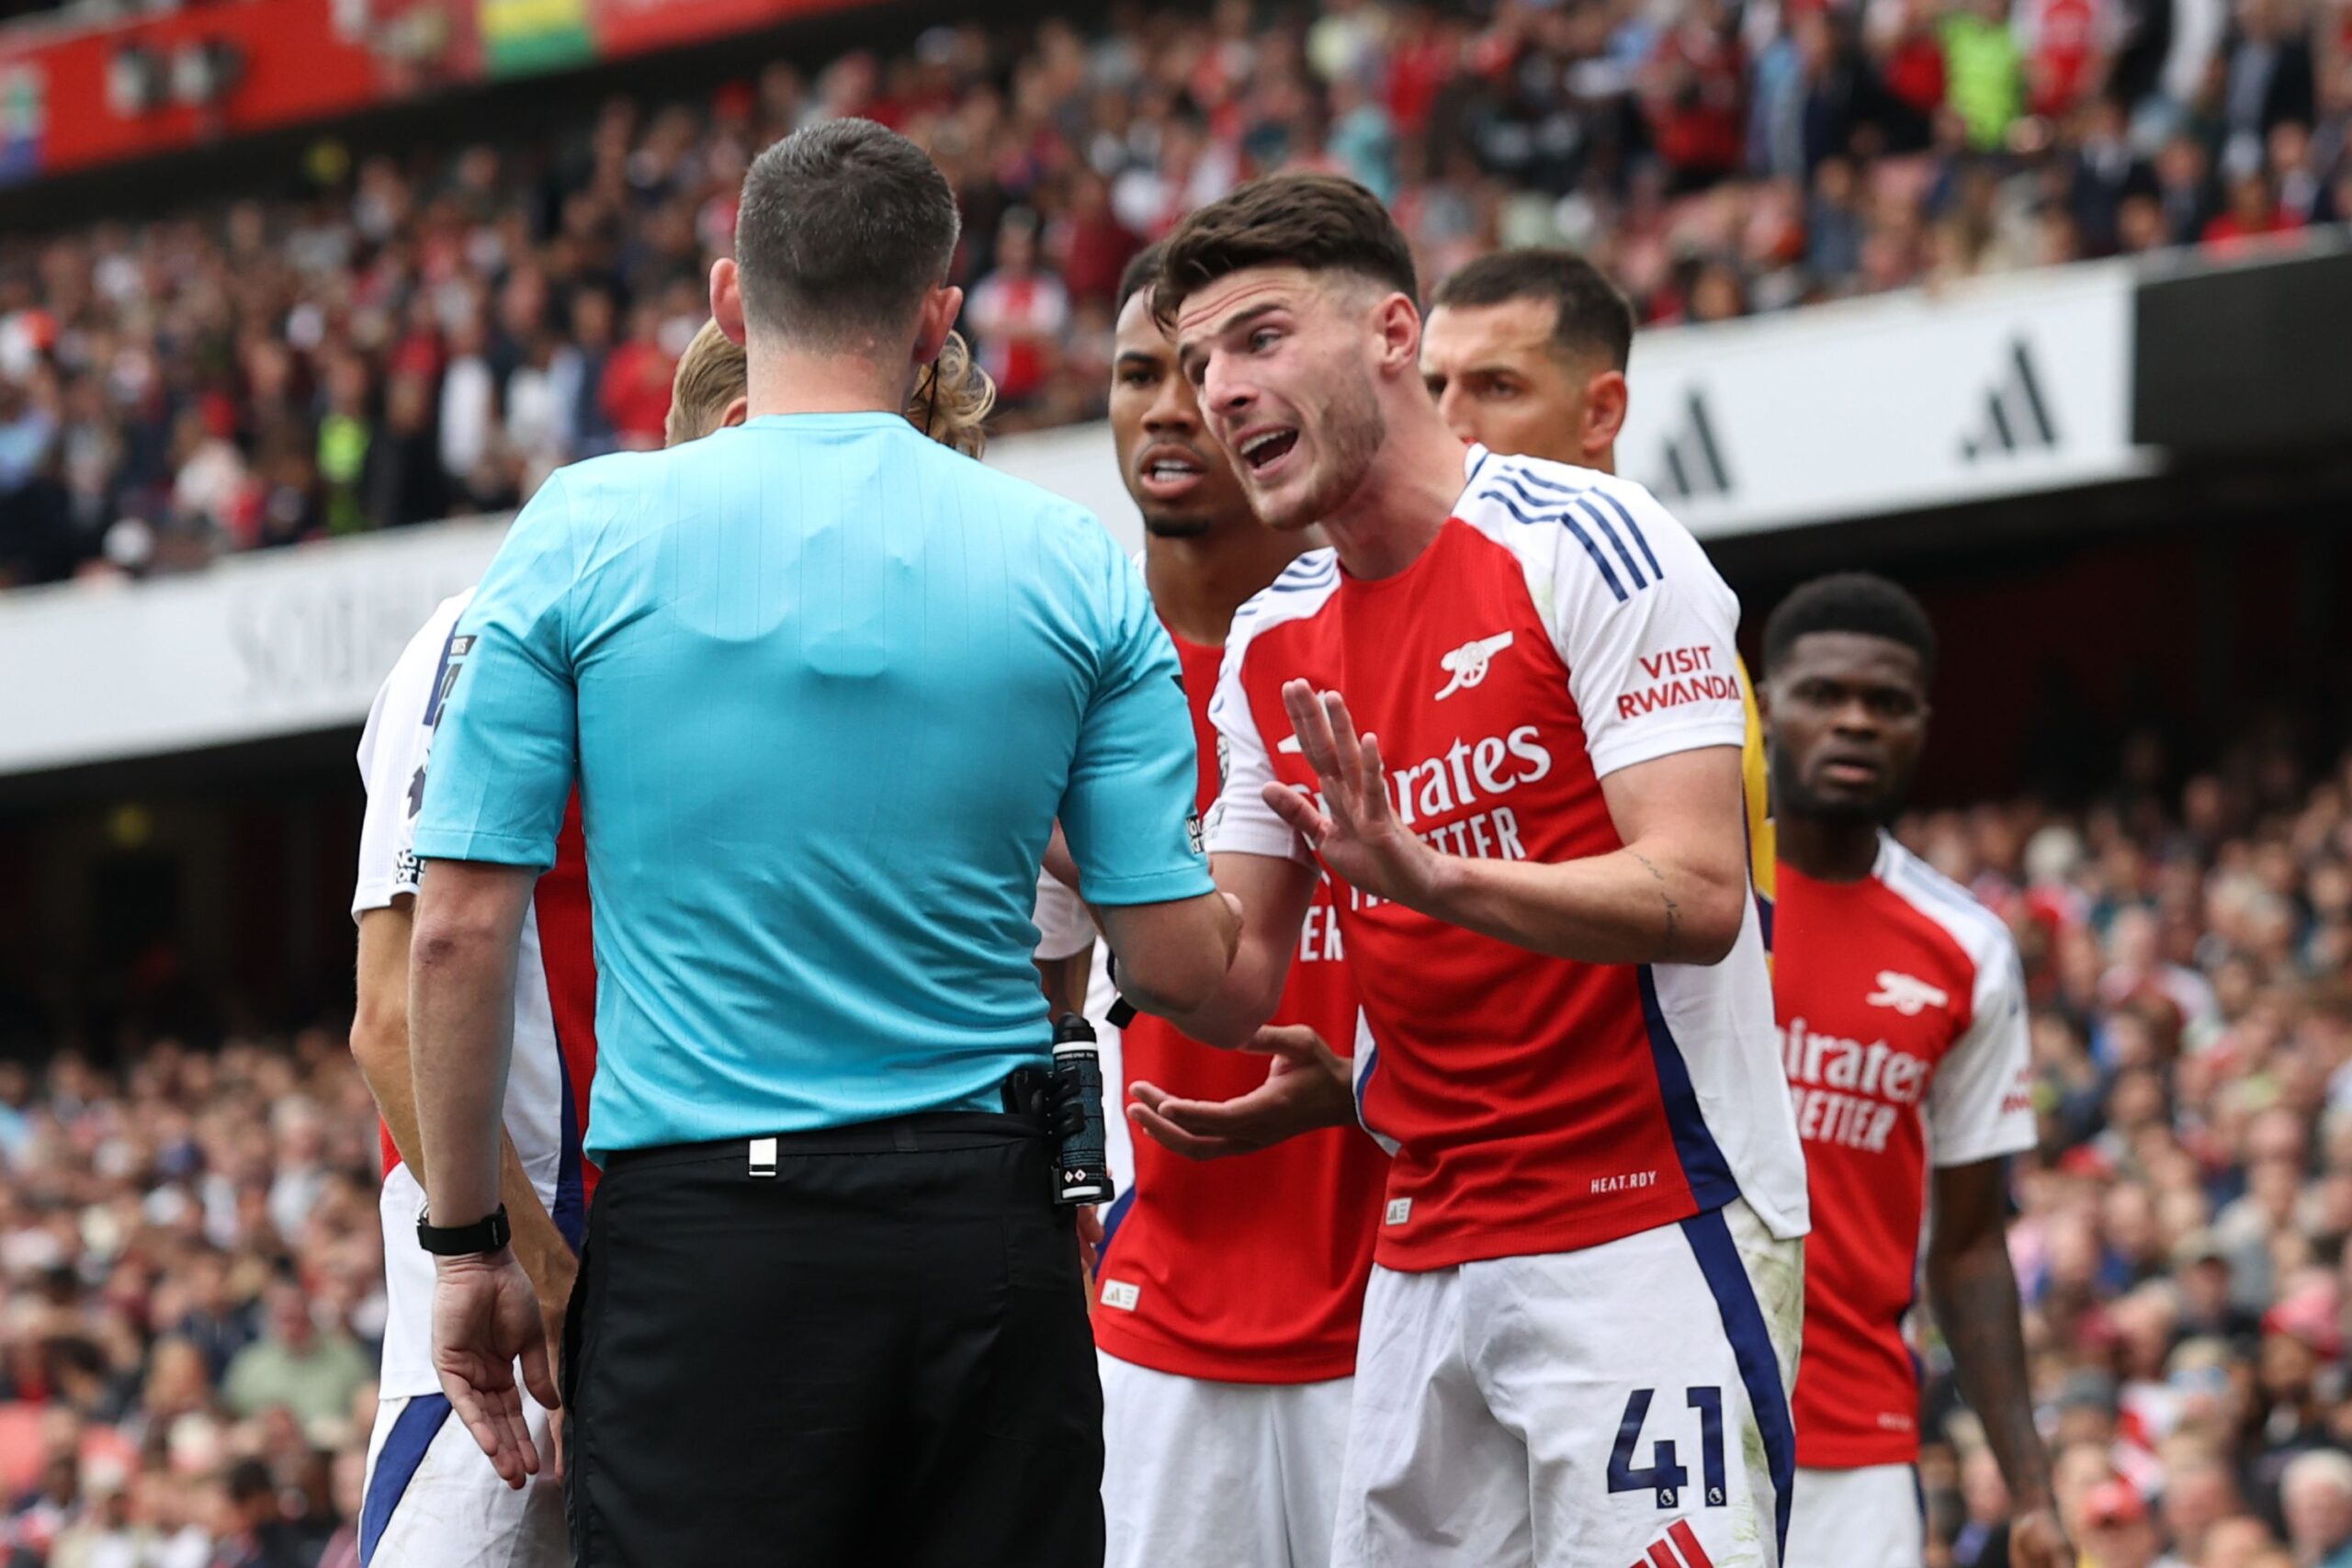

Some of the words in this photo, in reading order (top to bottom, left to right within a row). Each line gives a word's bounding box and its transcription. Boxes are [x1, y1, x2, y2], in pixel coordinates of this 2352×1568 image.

[1639, 646, 1712, 680] VISIT
[1617, 674, 1741, 720] RWANDA
[1416, 806, 1527, 862] TTER
[1792, 1084, 1898, 1154] ETTER
[1591, 1170, 1657, 1193] HEAT.RDY
[1606, 1385, 1727, 1509] 41
